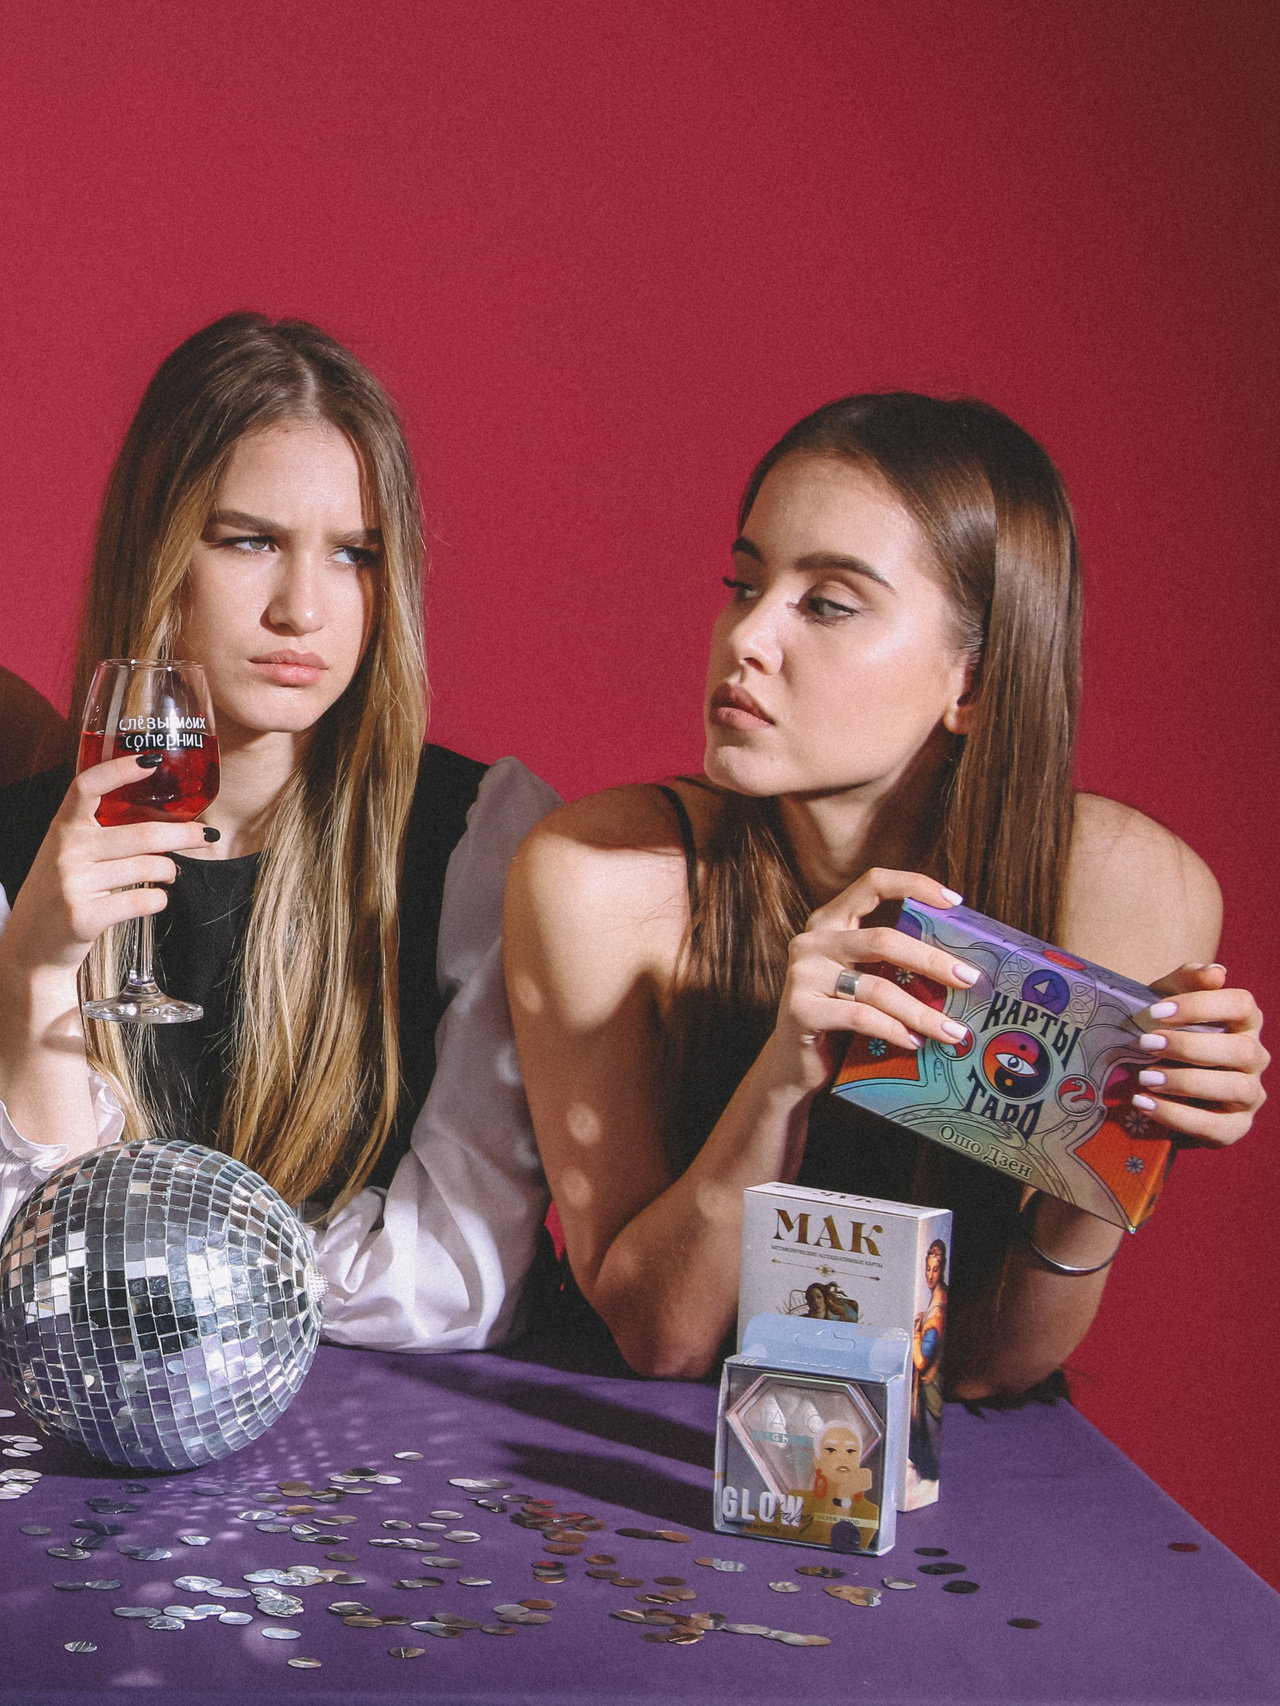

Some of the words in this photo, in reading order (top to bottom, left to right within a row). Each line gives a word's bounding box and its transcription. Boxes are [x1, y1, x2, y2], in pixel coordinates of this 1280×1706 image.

[118, 715, 170, 731] слёзы
[172, 716, 206, 730] моих
[125, 733, 204, 752] соперниц
[980, 991, 1083, 1072] КАРТЫ
[963, 1065, 1045, 1141] ТАРО
[940, 1125, 982, 1154] Ошо
[982, 1145, 1032, 1178] Дзен
[772, 1207, 884, 1257] МАК
[722, 1485, 804, 1528] GLOW
[817, 1514, 838, 1522] SILVER
